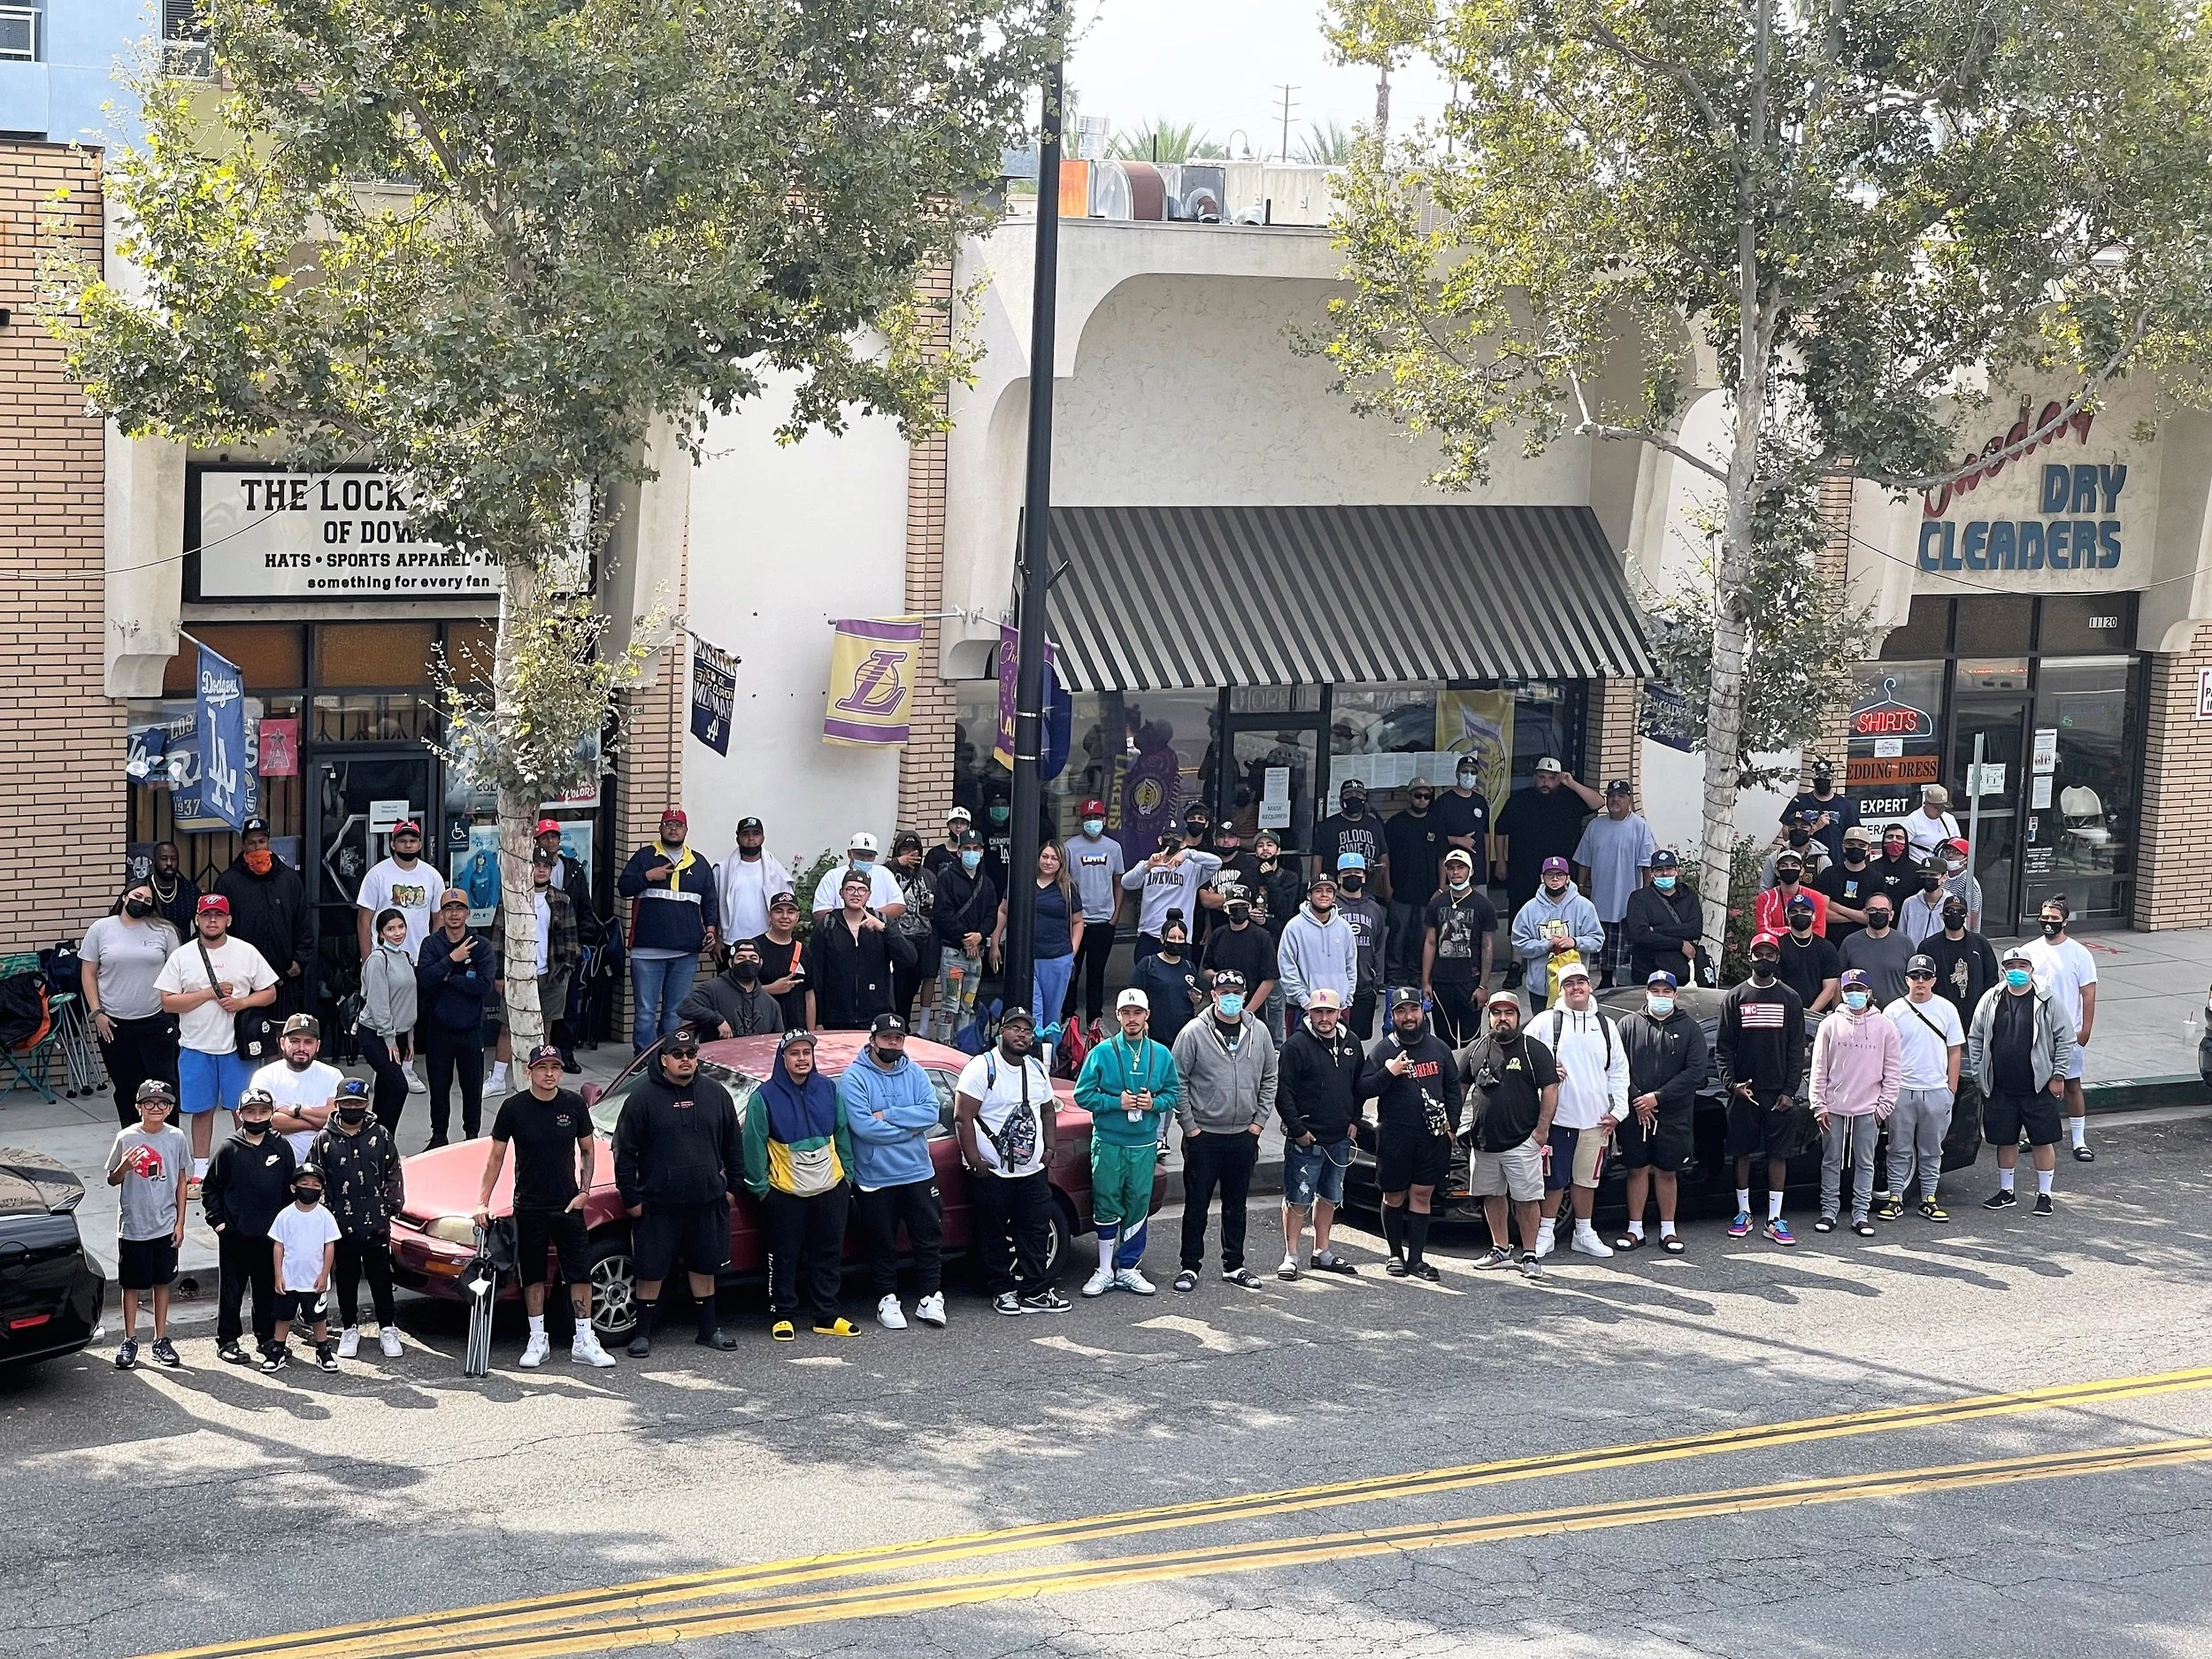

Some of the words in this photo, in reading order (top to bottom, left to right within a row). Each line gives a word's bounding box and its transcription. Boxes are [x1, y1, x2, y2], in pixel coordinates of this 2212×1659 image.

[241, 480, 307, 511] THE
[320, 480, 406, 511] LOCK
[2039, 465, 2127, 513] DRY
[324, 521, 352, 543] OF
[361, 521, 434, 543] DOW
[1918, 521, 2122, 571] CLEANERS
[265, 553, 320, 568] HATS
[326, 553, 390, 567] SPORTS
[396, 553, 471, 567] APPAREL
[307, 575, 391, 590] something
[395, 575, 417, 588] for
[420, 577, 464, 590] every
[466, 575, 490, 588] fan
[2089, 617, 2117, 628] 11120
[202, 670, 241, 708] Dodgers
[171, 714, 194, 740] LOS
[1857, 710, 1917, 733] SHIRTS
[207, 707, 237, 817] LA
[1846, 762, 1893, 780] EDDING
[1898, 761, 1937, 777] DRESS
[1108, 755, 1127, 829] LAKERS
[174, 799, 201, 816] 1937
[1860, 798, 1909, 814] EXPERT
[1339, 829, 1373, 844] BLOOD
[1338, 843, 1376, 857] SWEAT
[1917, 956, 1927, 966] NY
[1740, 1006, 1757, 1016] TMC
[1837, 1041, 1877, 1050] EQUALITY
